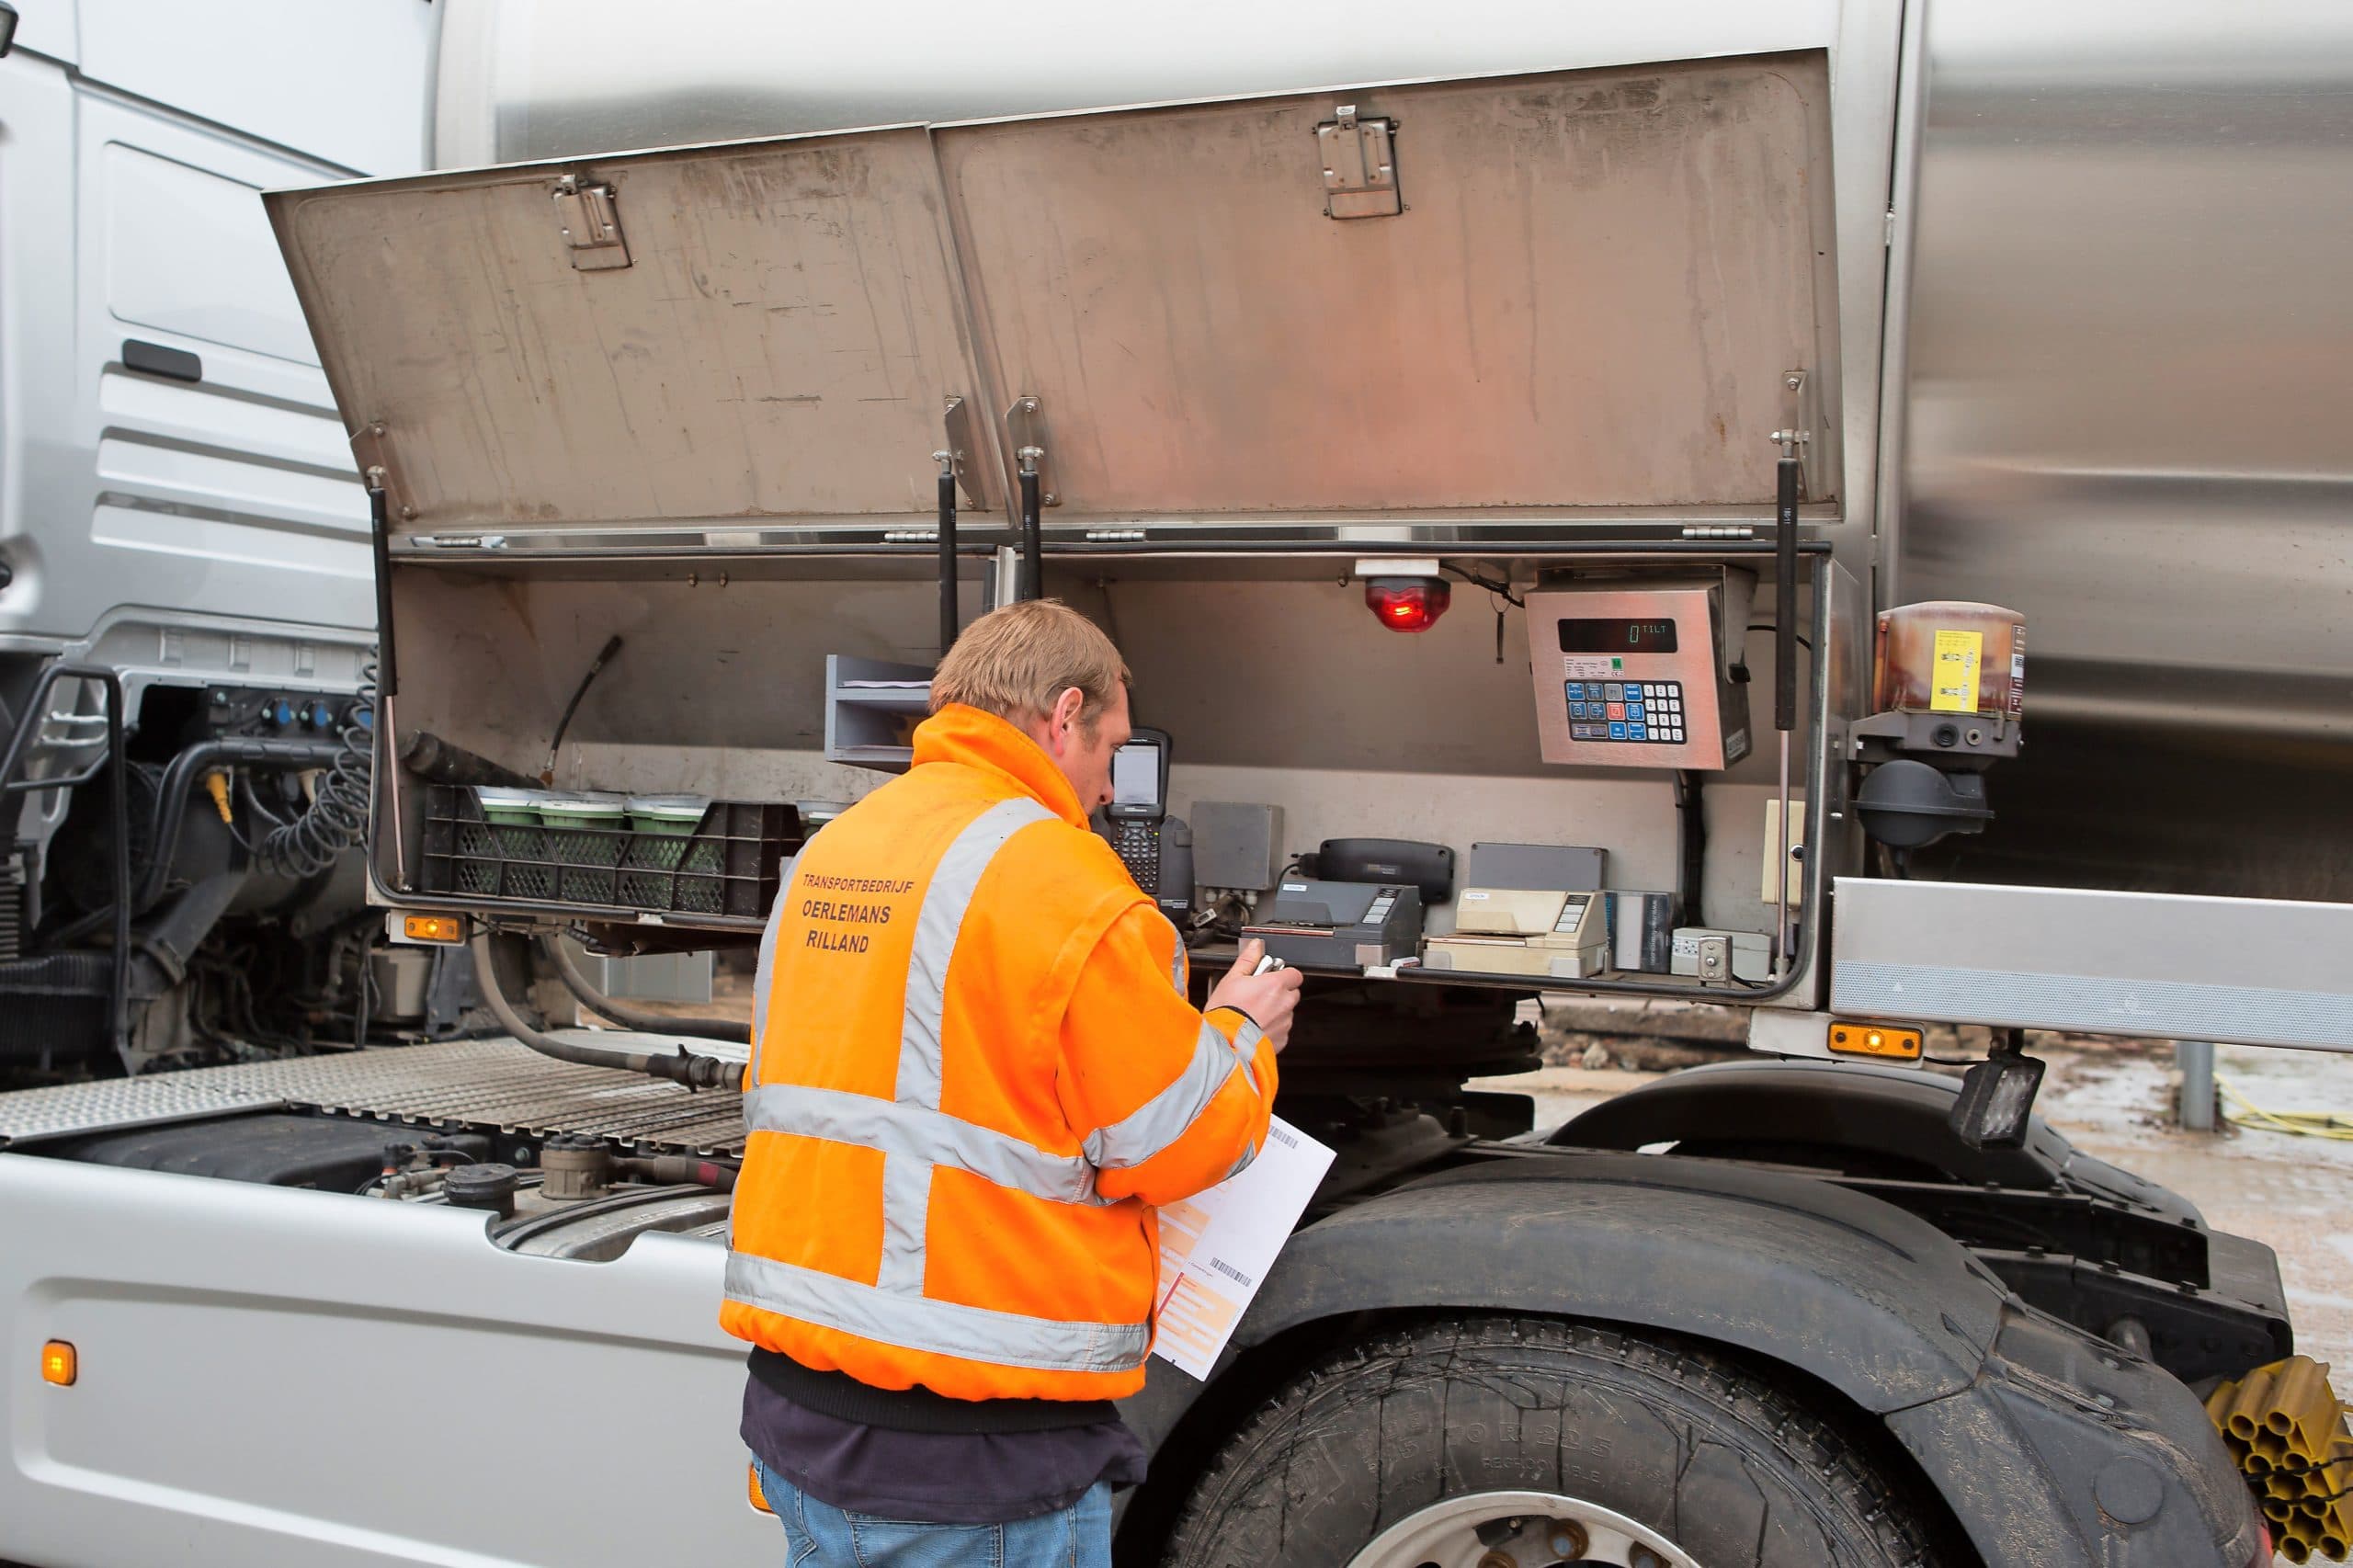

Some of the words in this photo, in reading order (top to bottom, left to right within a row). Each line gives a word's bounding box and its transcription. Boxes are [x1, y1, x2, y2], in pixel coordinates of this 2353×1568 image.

[1643, 625, 1666, 633] TILT
[802, 873, 915, 894] TRANSPORTBEDRIJF
[802, 899, 892, 925] OERLEMANS
[806, 929, 870, 954] RILLAND
